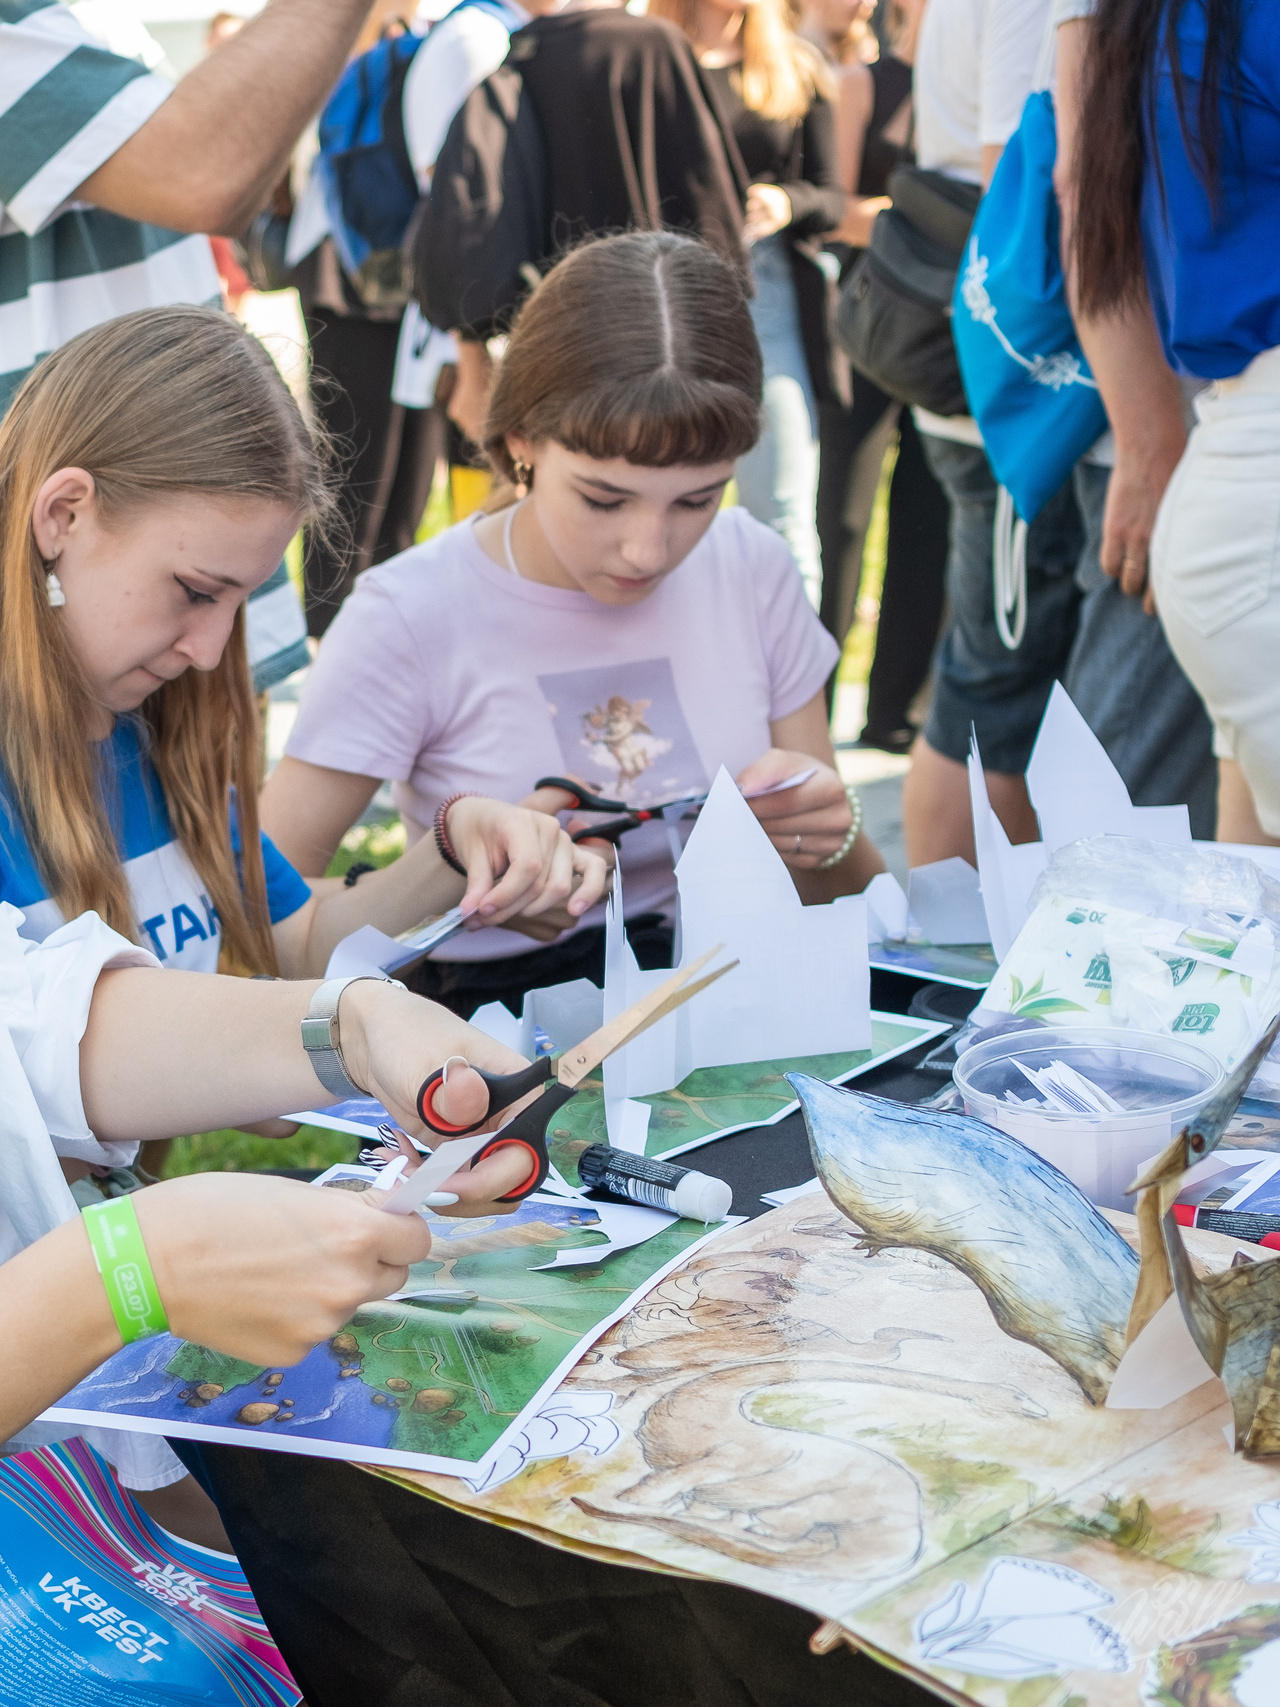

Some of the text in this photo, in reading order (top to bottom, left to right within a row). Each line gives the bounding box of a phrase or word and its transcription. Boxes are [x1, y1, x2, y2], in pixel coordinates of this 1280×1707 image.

[1089, 911, 1108, 925] 20
[121, 1270, 144, 1312] 23.07
[132, 1561, 209, 1611] fest
[134, 1580, 179, 1607] 2022
[162, 1563, 210, 1598] VK
[38, 1571, 164, 1664] VK FEST
[62, 1576, 170, 1647] КВЕСТ
